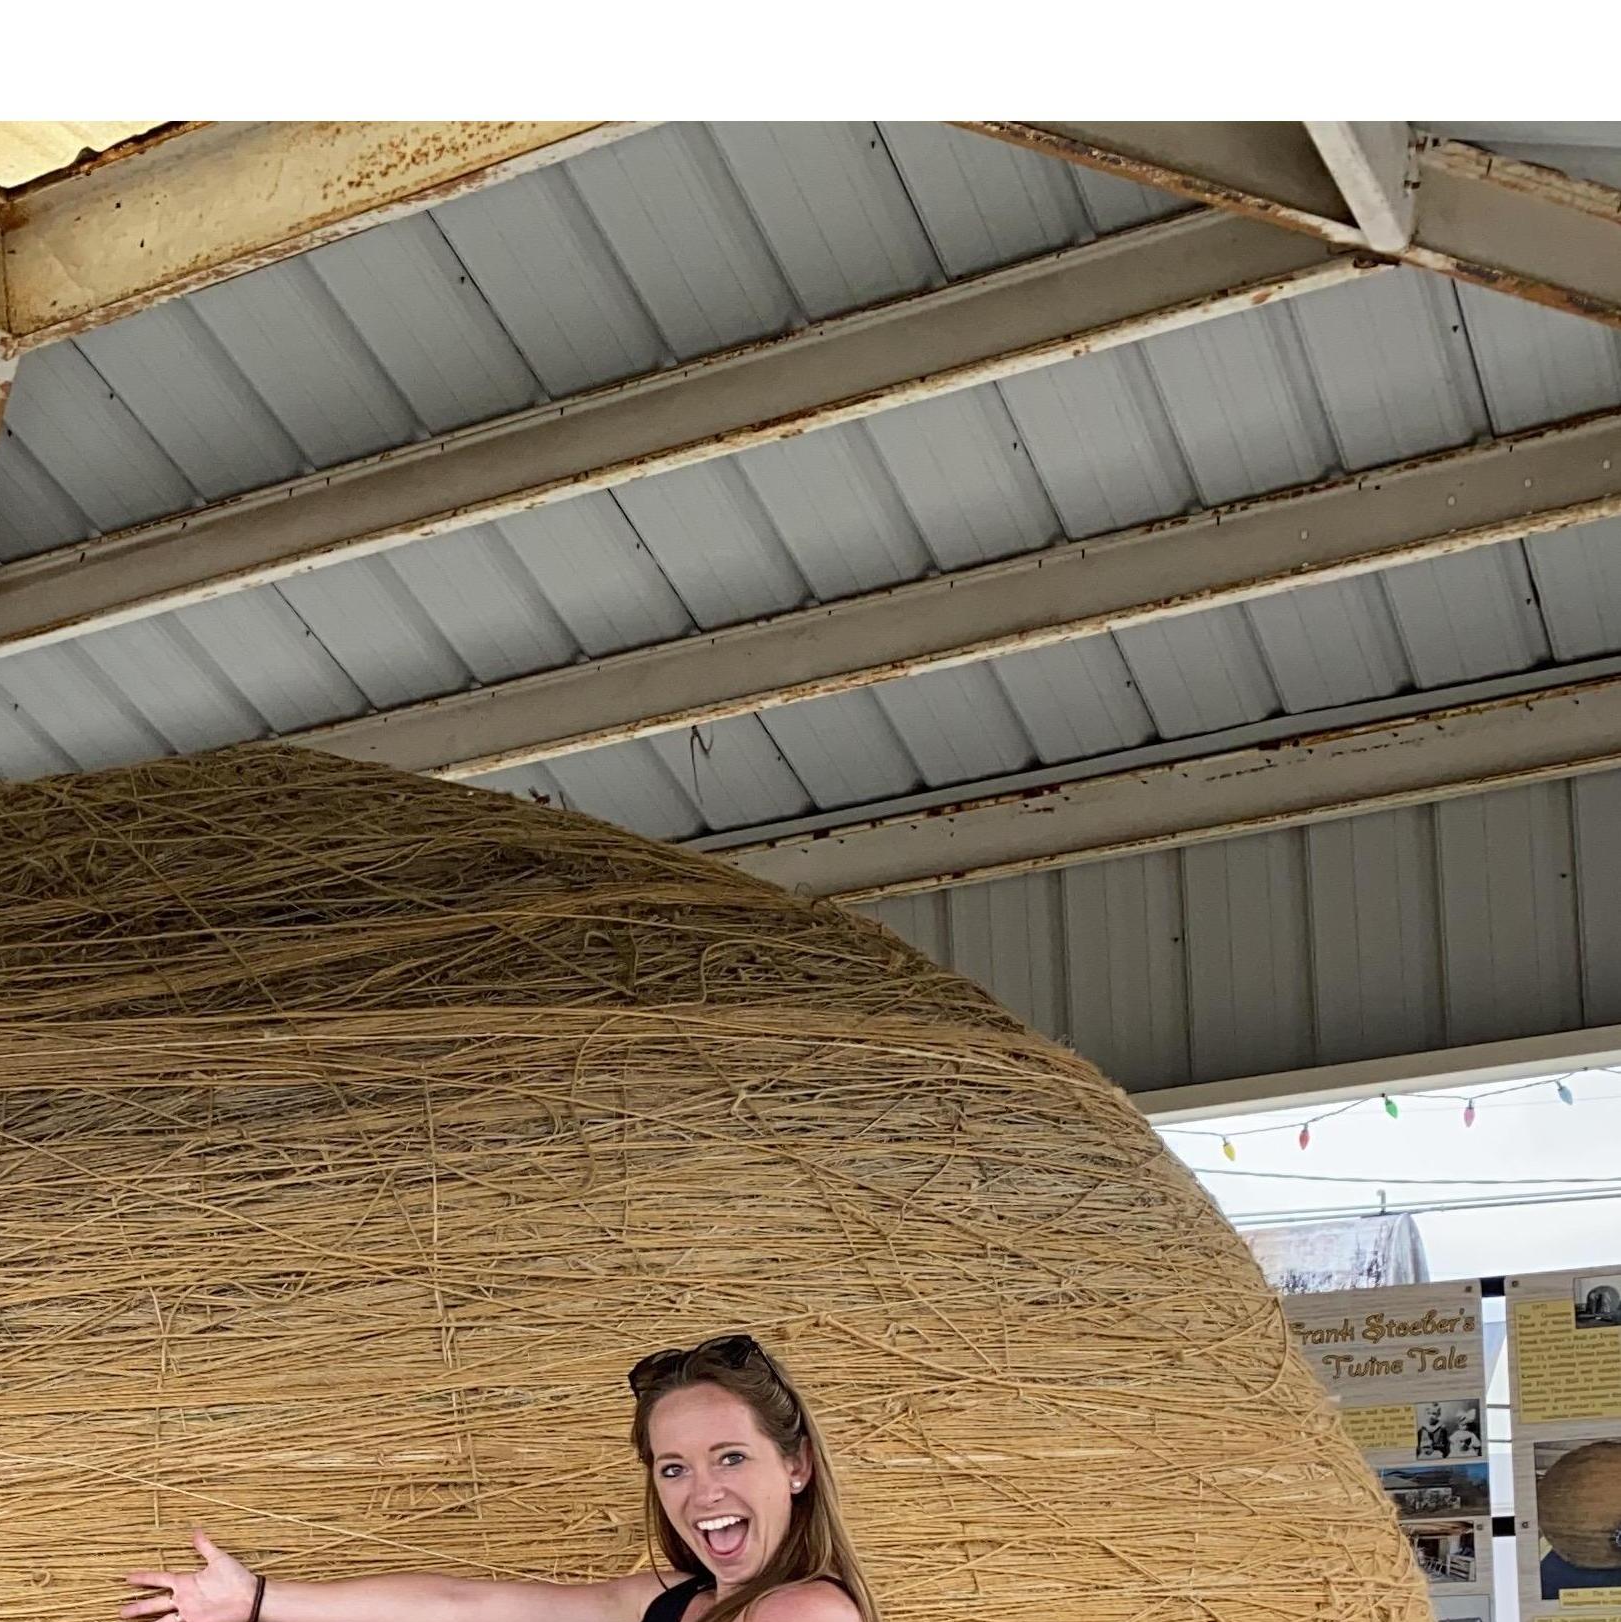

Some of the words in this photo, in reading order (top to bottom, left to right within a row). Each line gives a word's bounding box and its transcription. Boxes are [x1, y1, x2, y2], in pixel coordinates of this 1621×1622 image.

[1289, 1318, 1355, 1345] Frank
[1362, 1308, 1475, 1344] Stoeber's
[1322, 1354, 1404, 1379] Twine
[1407, 1346, 1468, 1373] Tale
